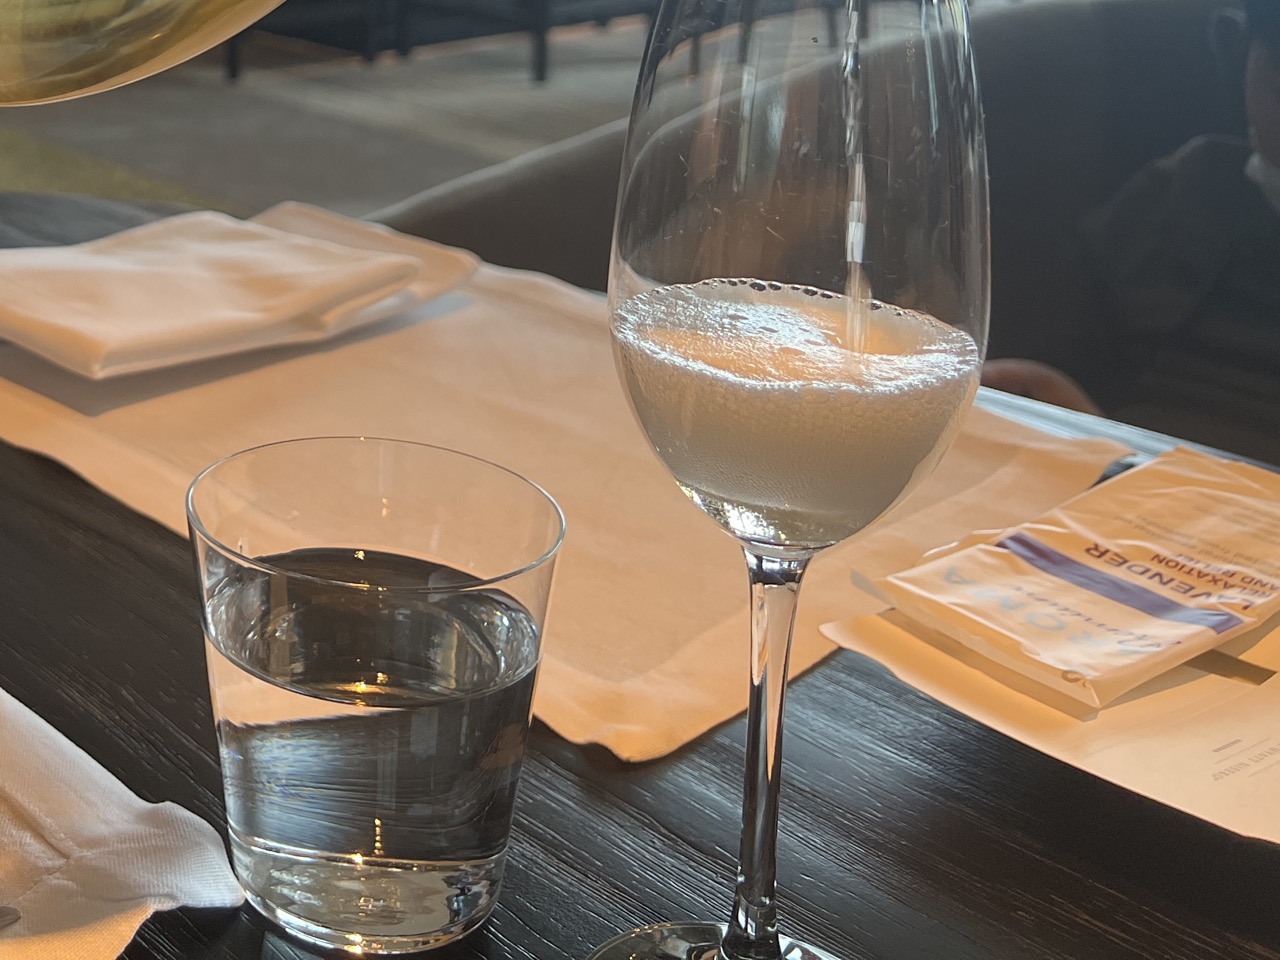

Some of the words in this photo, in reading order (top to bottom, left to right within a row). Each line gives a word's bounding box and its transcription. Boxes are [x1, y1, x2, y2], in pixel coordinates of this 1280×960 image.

[1084, 543, 1257, 611] LAVENDER
[1151, 553, 1272, 599] RELAXATION
[1239, 574, 1280, 592] AND
